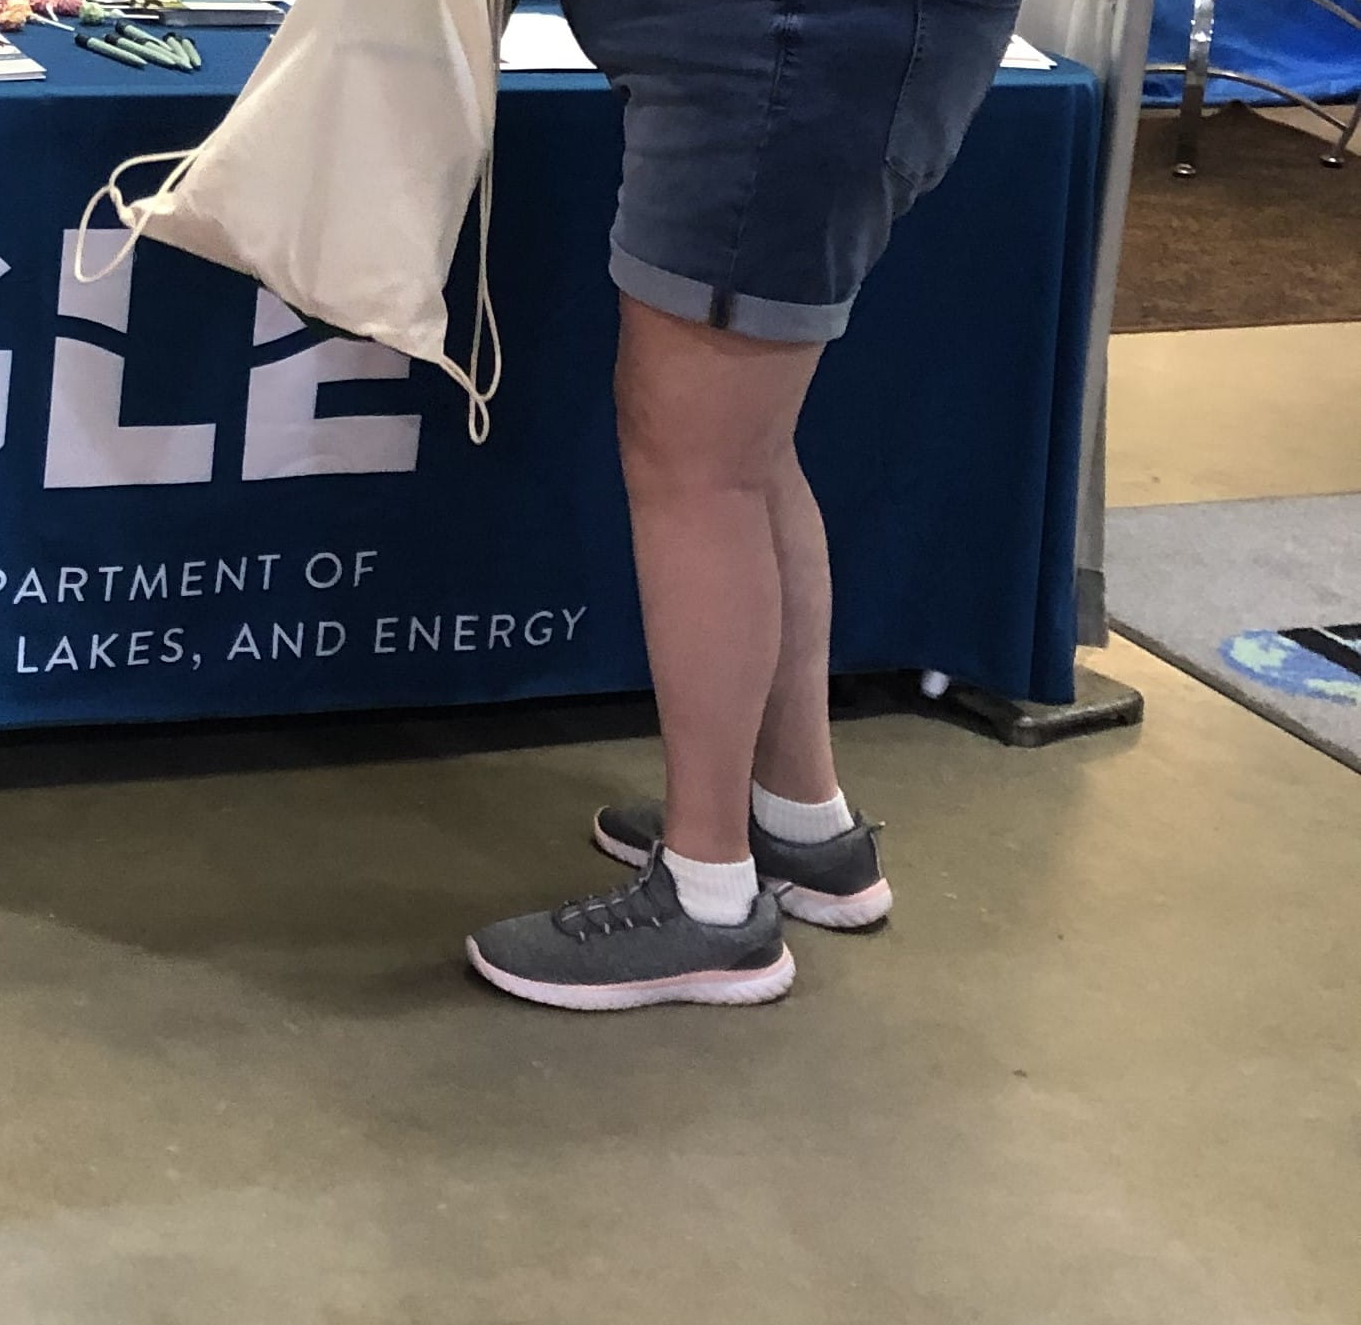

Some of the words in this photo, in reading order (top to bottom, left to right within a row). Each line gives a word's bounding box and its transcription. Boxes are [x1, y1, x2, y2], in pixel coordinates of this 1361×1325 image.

[305, 550, 378, 589] OF
[17, 627, 201, 674] LAKES,
[227, 620, 346, 661] AND
[373, 605, 588, 654] ENERGY
